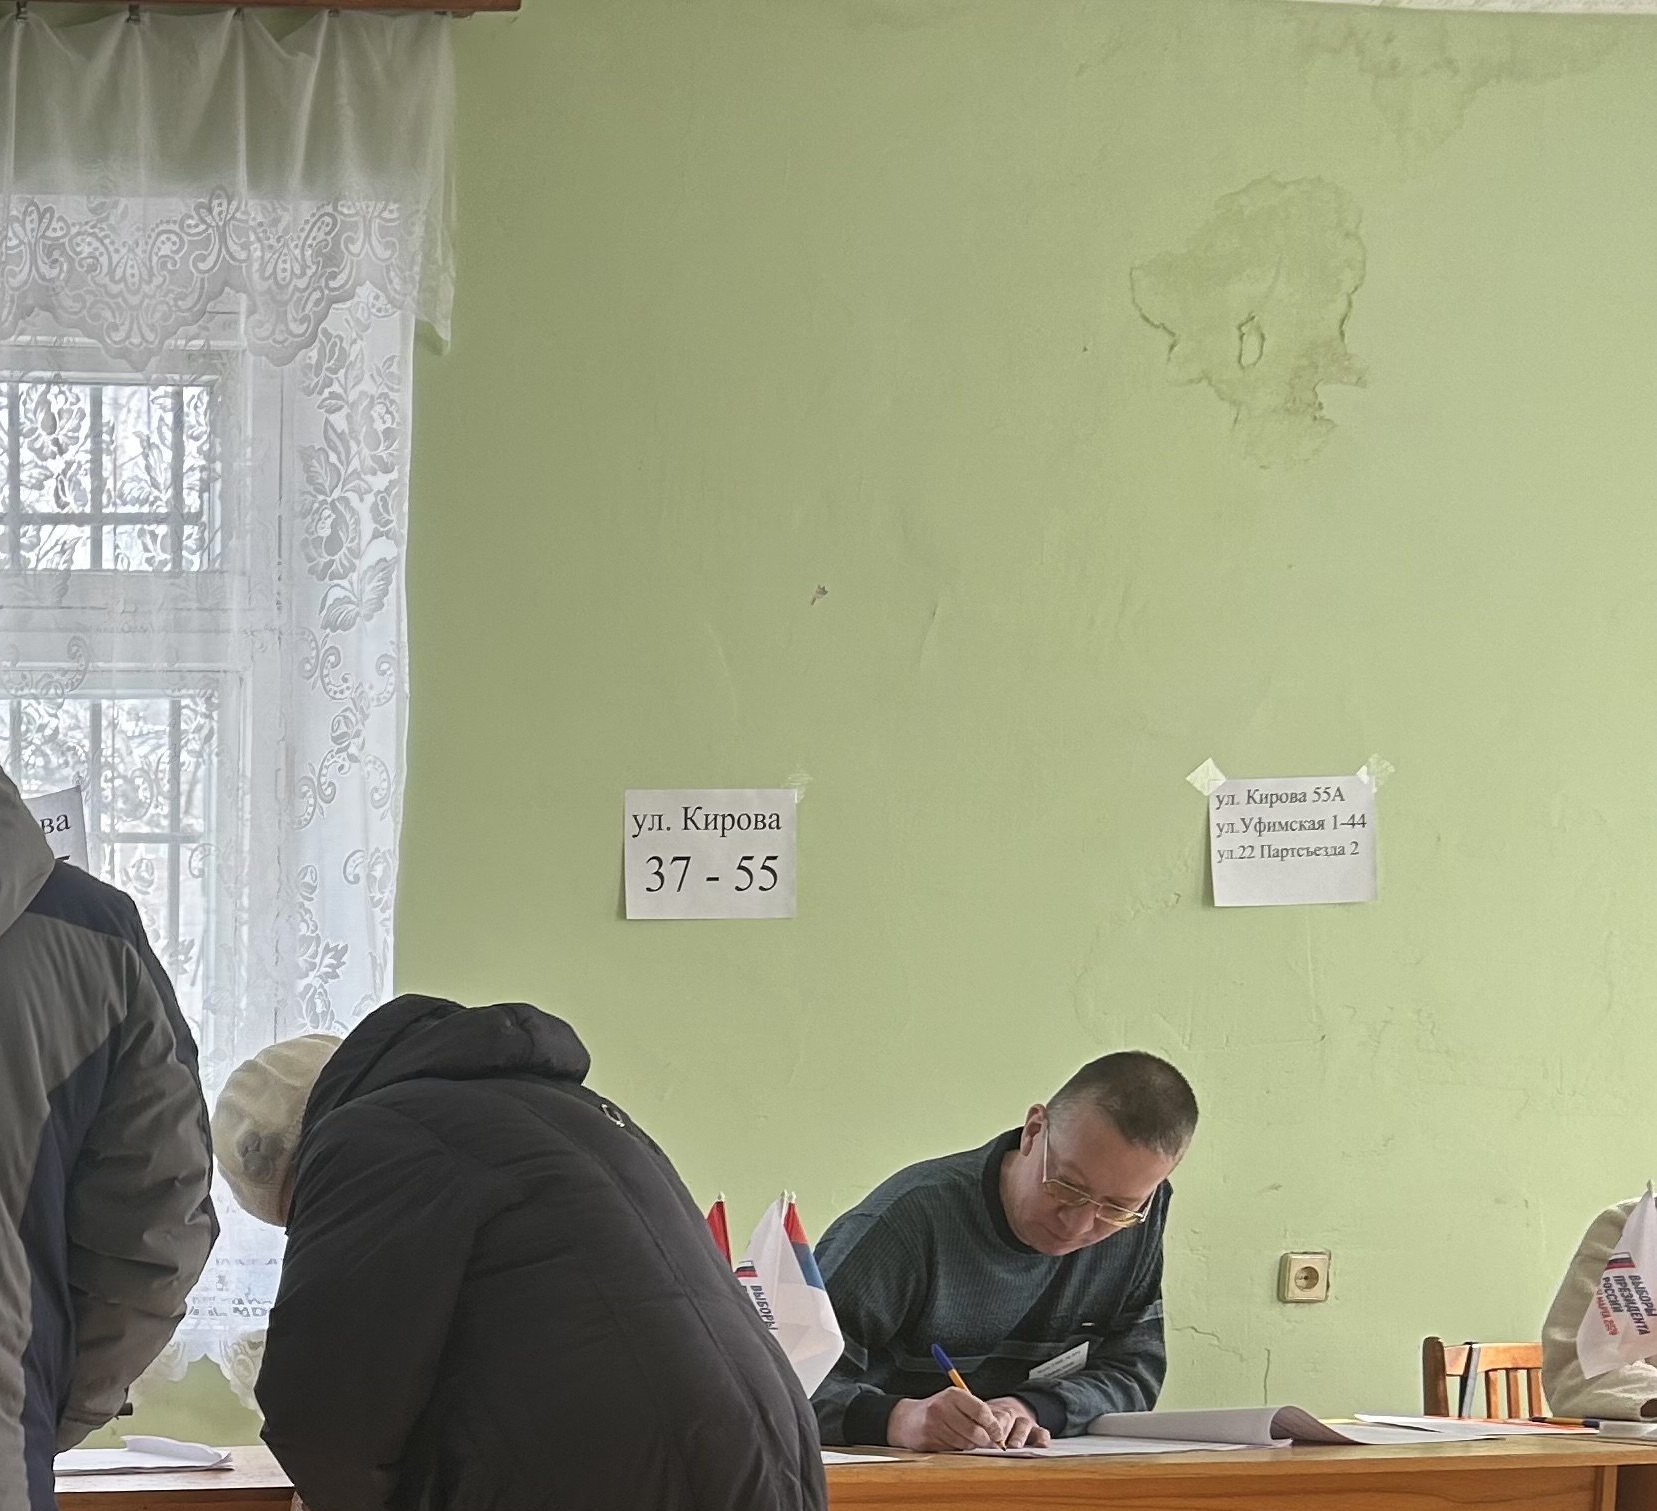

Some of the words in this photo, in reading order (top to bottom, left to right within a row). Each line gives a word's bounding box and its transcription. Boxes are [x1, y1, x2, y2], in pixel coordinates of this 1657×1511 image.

[1215, 793, 1240, 810] ул.
[1245, 788, 1308, 808] Кирова
[631, 813, 671, 838] ул.
[681, 806, 783, 838] Кирова
[1332, 813, 1368, 831] 1-44
[1260, 843, 1347, 862] Партсъезда
[1350, 841, 1360, 856] 2
[645, 855, 692, 893] 37
[734, 855, 779, 892] 55
[749, 1285, 779, 1330] ВЫБОРЫ
[1612, 1275, 1651, 1336] ПРЕЗИДЕНТА
[1628, 1274, 1657, 1317] ВЫБОРЫ
